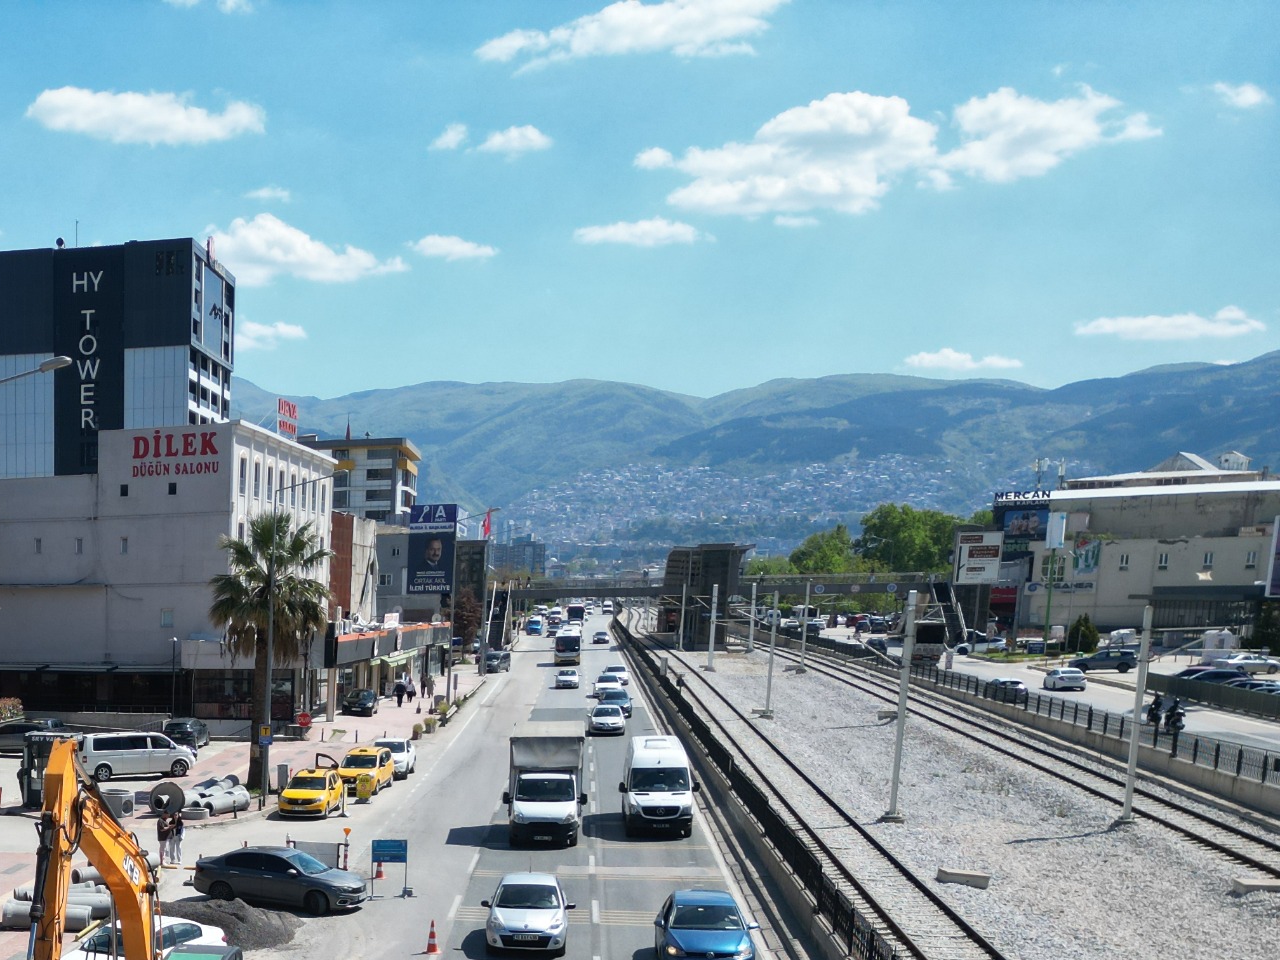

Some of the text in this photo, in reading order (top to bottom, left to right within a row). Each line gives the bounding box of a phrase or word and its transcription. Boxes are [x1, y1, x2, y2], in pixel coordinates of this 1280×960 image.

[72, 271, 104, 293] HY
[76, 309, 101, 429] TOWER
[132, 430, 219, 459] DİLEK
[132, 461, 219, 478] DÜĞÜN SALONU
[994, 490, 1051, 500] MERCAN
[435, 505, 447, 518] A
[263, 727, 269, 735] T
[123, 854, 140, 886] JCB
